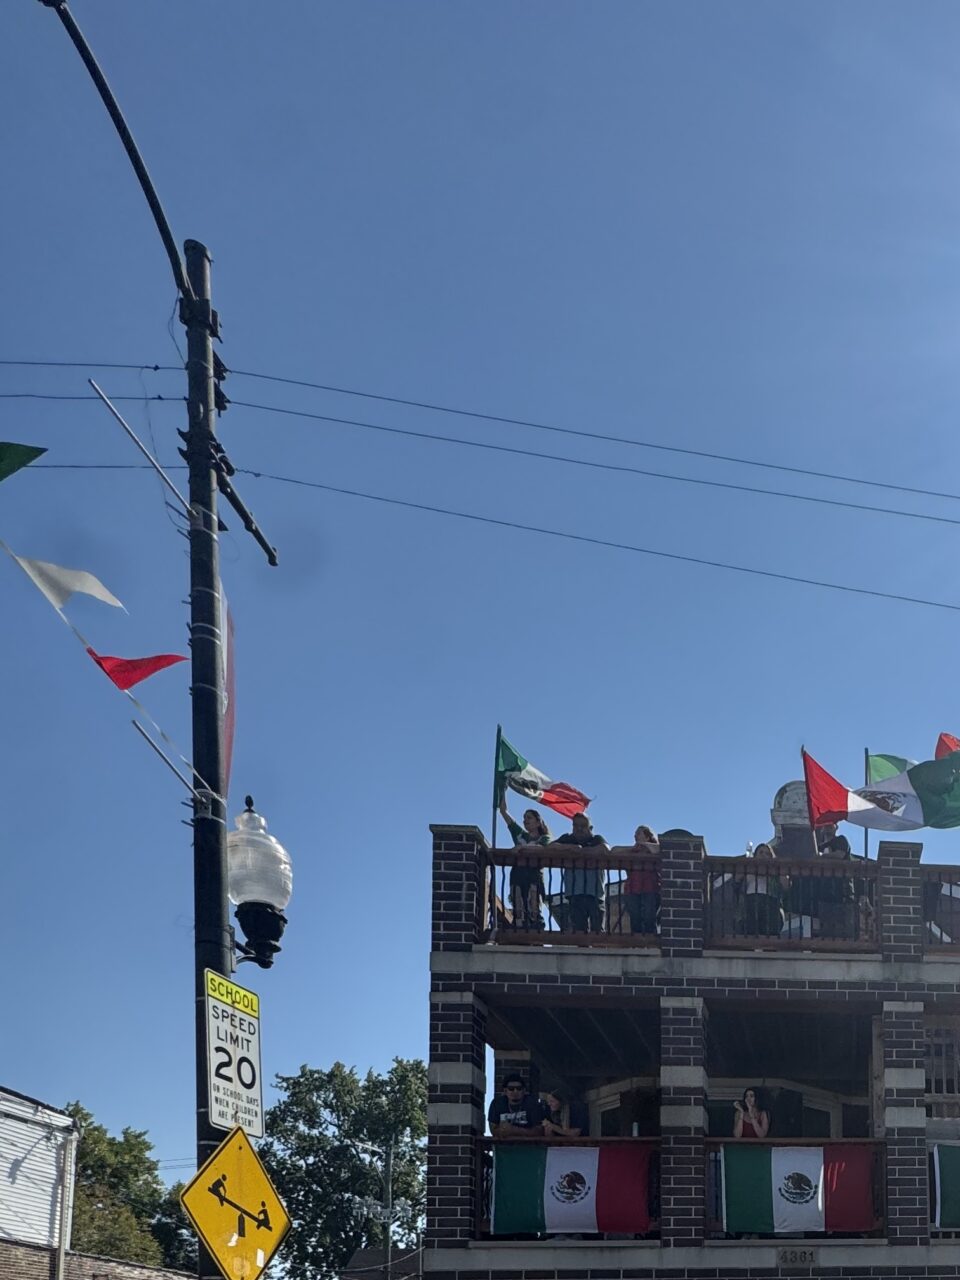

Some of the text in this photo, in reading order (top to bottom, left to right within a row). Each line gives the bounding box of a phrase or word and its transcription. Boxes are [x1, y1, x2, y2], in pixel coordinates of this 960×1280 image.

[210, 978, 257, 1012] SCHOOL
[212, 1005, 256, 1036] SPEED
[216, 1026, 252, 1052] LIMIT
[214, 1046, 256, 1089] 20
[214, 1096, 258, 1118] WHEN CHILDREN
[223, 1086, 244, 1102] SCHOOL
[246, 1094, 259, 1107] DAYS
[218, 1109, 254, 1128] ARE PRESENT
